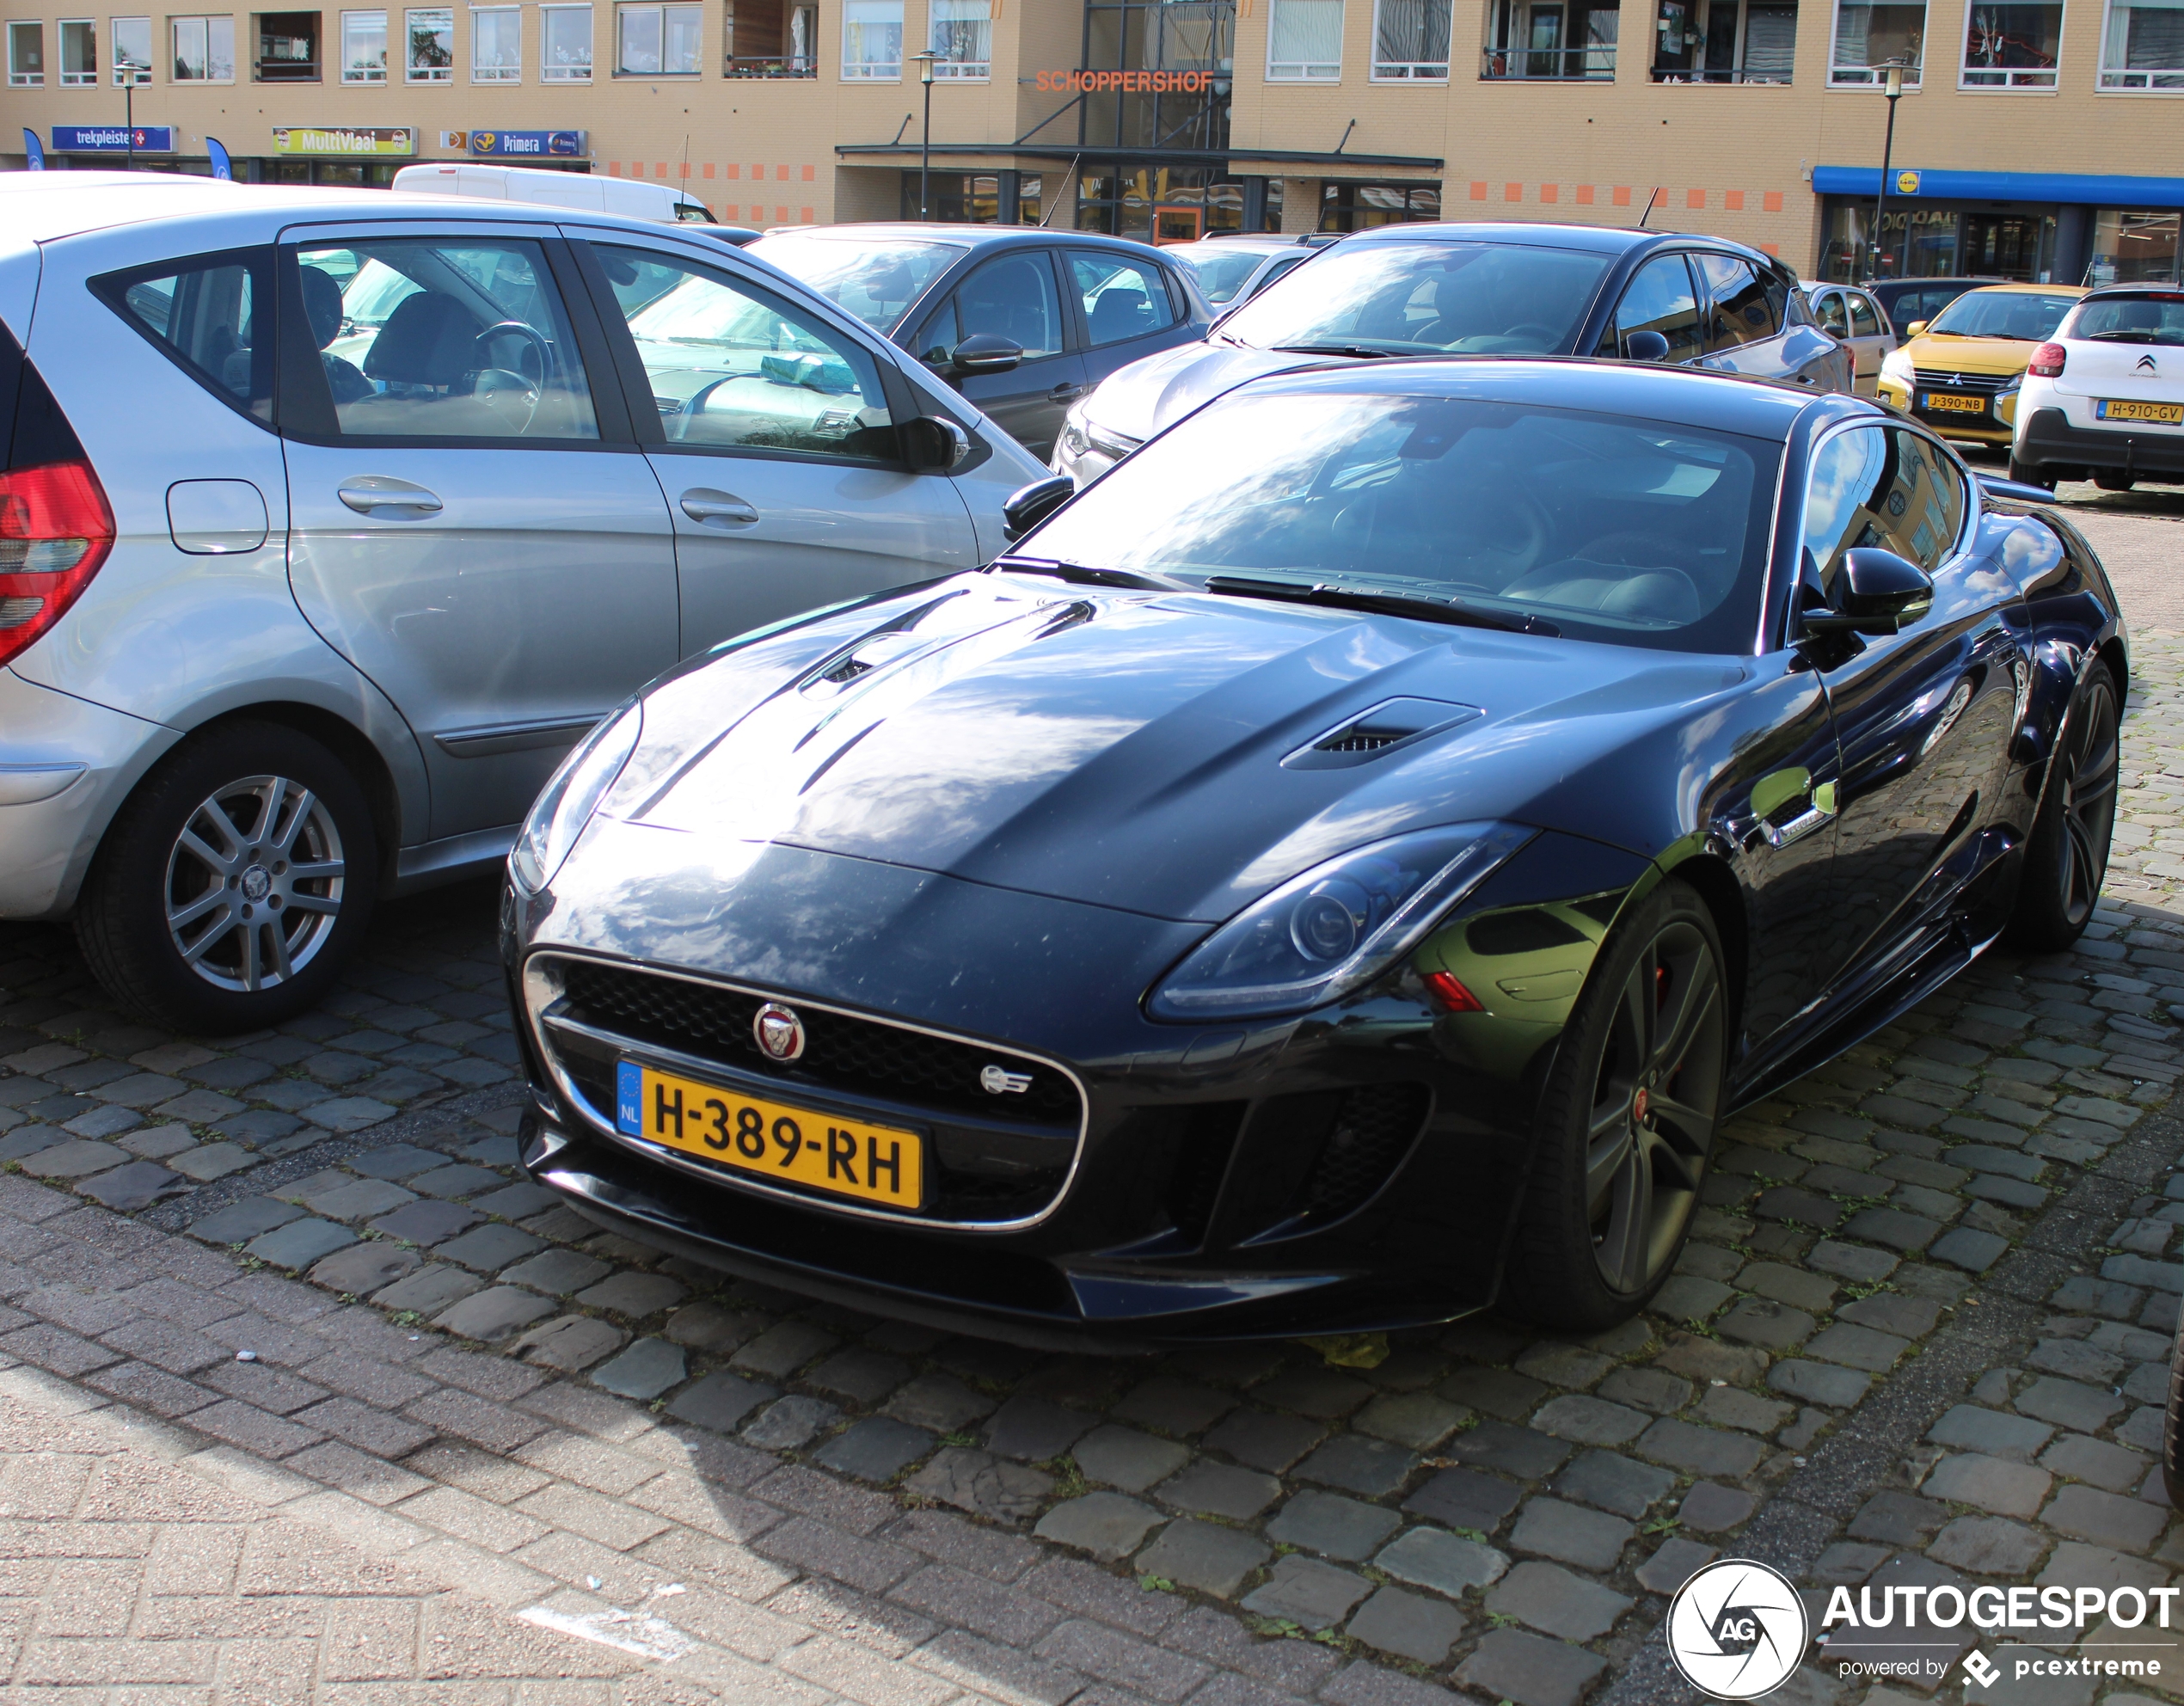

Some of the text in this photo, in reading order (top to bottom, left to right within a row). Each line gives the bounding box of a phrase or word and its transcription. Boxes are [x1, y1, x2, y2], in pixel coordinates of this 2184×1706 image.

[1036, 71, 1214, 92] SCHOPPERSHOF
[303, 131, 377, 151] MultiVlaai
[504, 135, 540, 152] Primera
[560, 138, 575, 148] Primera
[1931, 396, 1980, 409] J-390-NB
[2112, 404, 2178, 420] H-910-GV
[1786, 815, 1816, 837] JAGUAR
[621, 1104, 639, 1124] NL
[655, 1083, 900, 1194] H-389-RH
